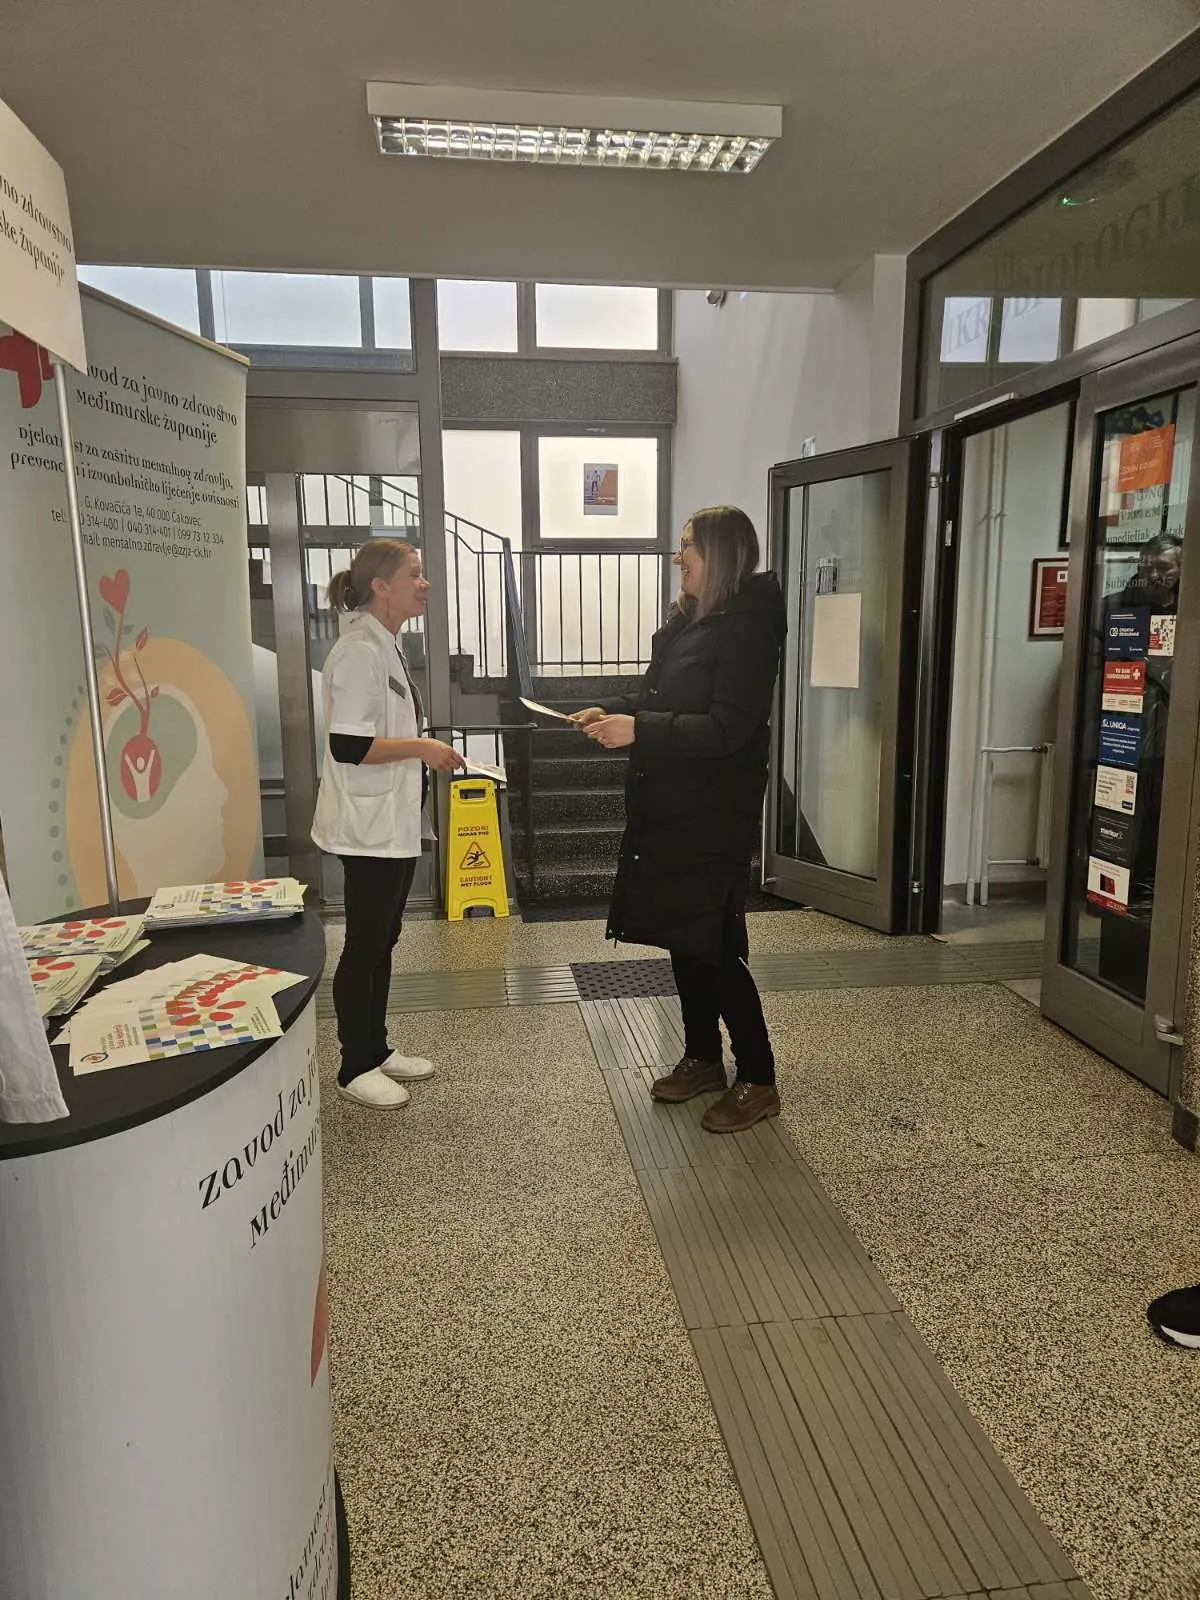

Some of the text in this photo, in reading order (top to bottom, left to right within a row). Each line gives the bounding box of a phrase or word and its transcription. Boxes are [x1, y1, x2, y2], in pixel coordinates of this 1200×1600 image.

[0, 174, 72, 253] no zdravstvo
[19, 226, 65, 287] županije
[75, 388, 218, 448] Međimurske županije
[121, 375, 140, 393] za
[141, 374, 179, 407] javno
[182, 393, 238, 427] zdravstvo
[10, 451, 79, 477] prevenc
[86, 462, 161, 494] izvanbolničko
[161, 479, 201, 505] liječenje
[201, 490, 240, 510] ovisnosti
[18, 423, 233, 490] Djelatst za zaštitu mentalnog zdravlja,
[86, 513, 119, 531] 314-400
[127, 520, 143, 535] 040
[177, 528, 191, 542] 099
[146, 506, 156, 520] 40
[157, 508, 171, 522] 000
[171, 508, 202, 527] Čakovec
[199, 1090, 285, 1210] zavod
[288, 1077, 307, 1120] za
